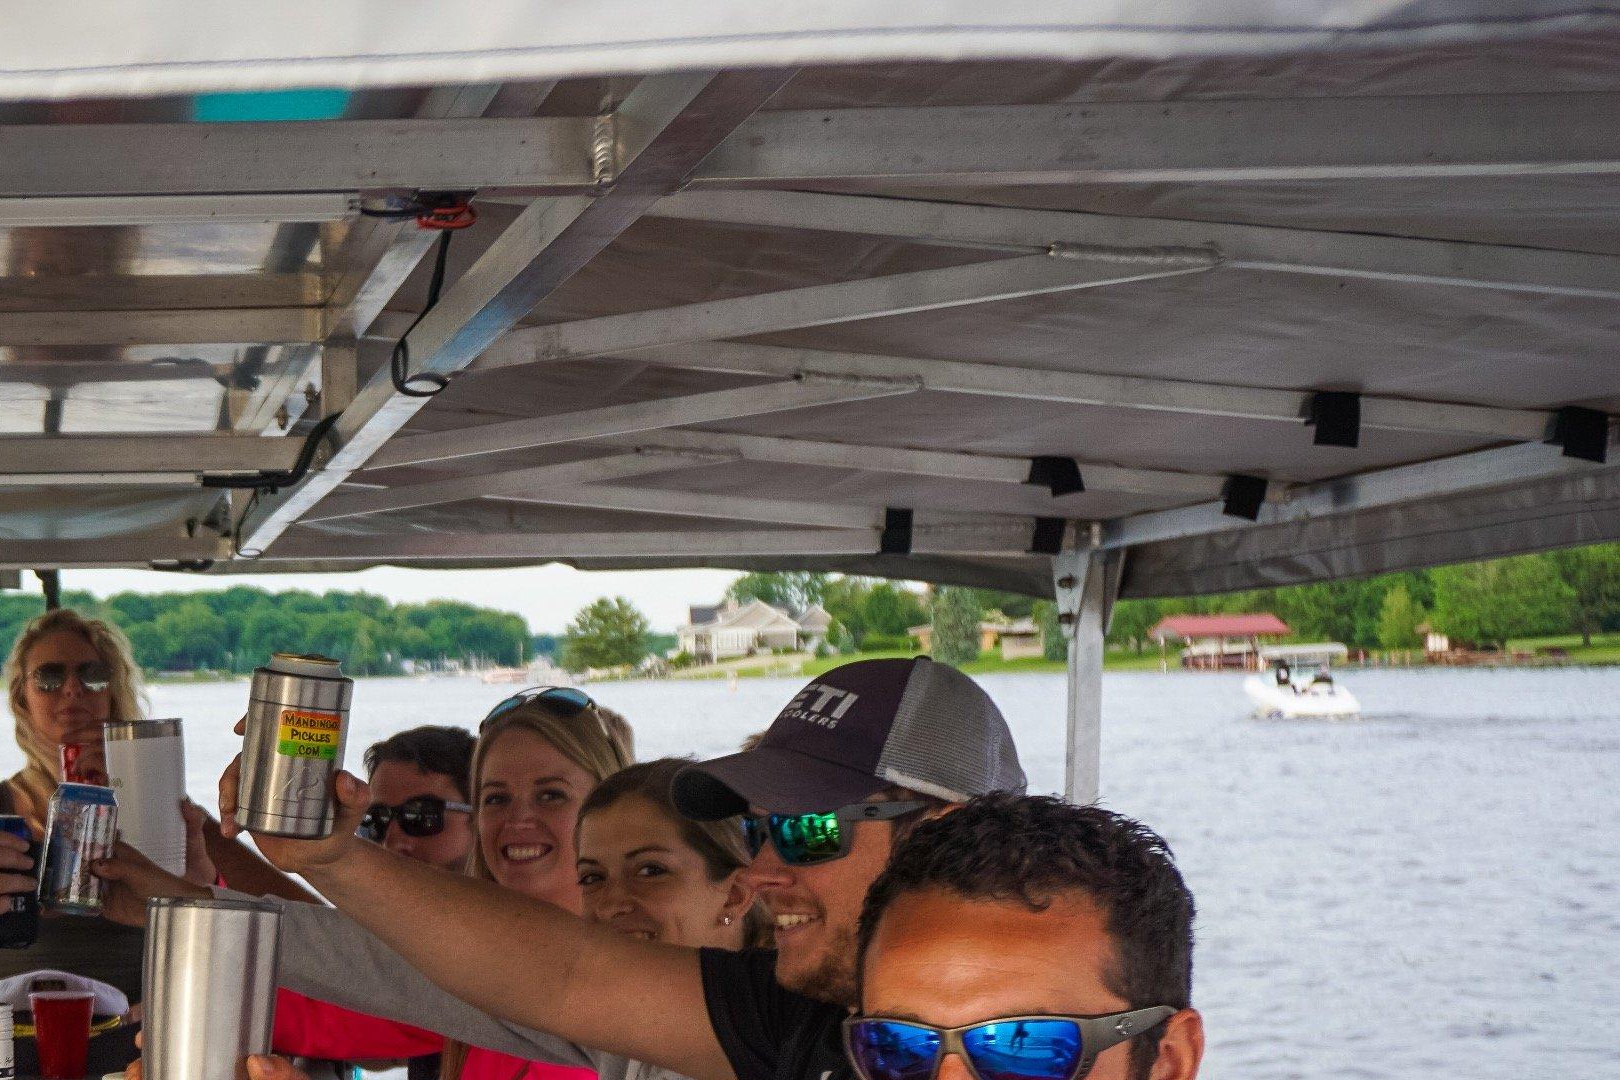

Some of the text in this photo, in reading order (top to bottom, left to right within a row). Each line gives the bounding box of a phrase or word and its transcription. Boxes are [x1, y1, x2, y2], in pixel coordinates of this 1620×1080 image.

[785, 684, 860, 720] ETI
[284, 713, 339, 730] MANDINGO
[290, 727, 331, 743] PICKLES
[295, 744, 320, 757] .COM
